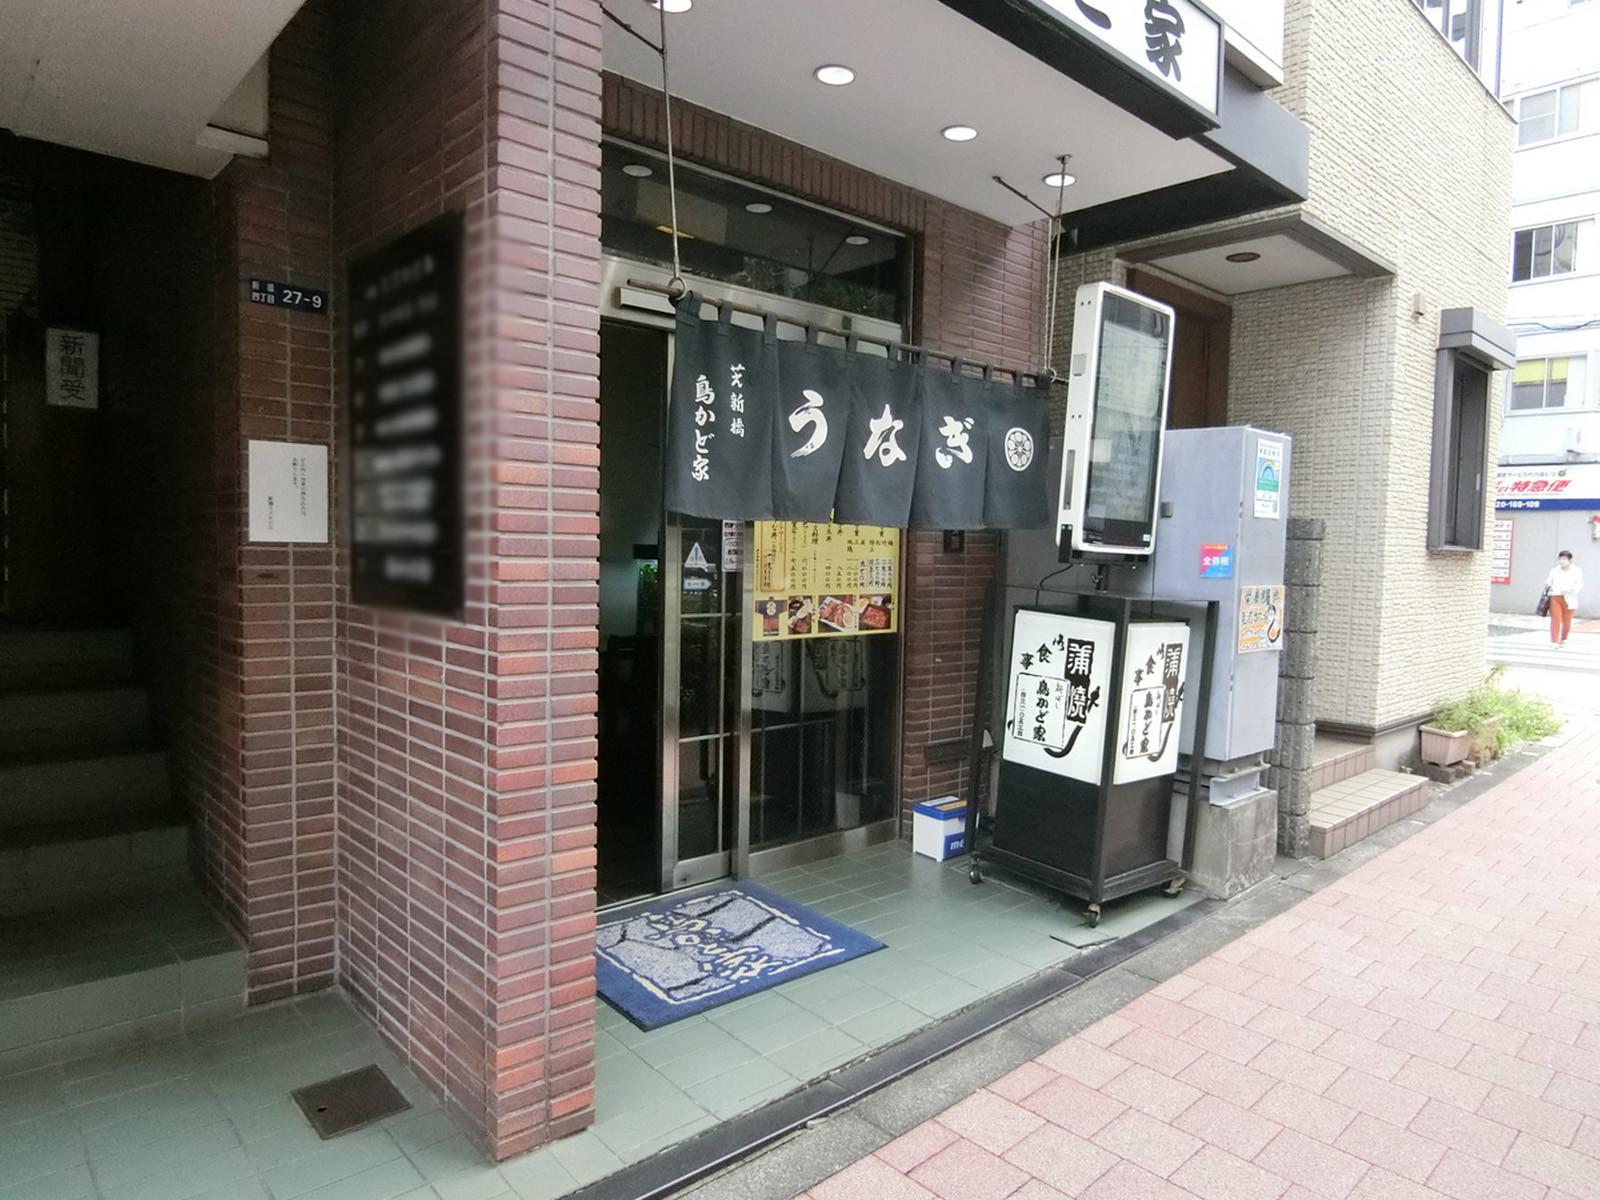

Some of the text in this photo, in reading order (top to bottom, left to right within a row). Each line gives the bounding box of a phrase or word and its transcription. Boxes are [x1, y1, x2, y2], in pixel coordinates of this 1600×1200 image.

[282, 289, 323, 309] 27-9
[59, 333, 86, 402] 新聞受
[691, 373, 716, 482] 鳥かど家
[788, 389, 975, 470] うなぎ
[1032, 679, 1050, 742] 鳥かど家
[1139, 689, 1154, 754] 鳥かど家
